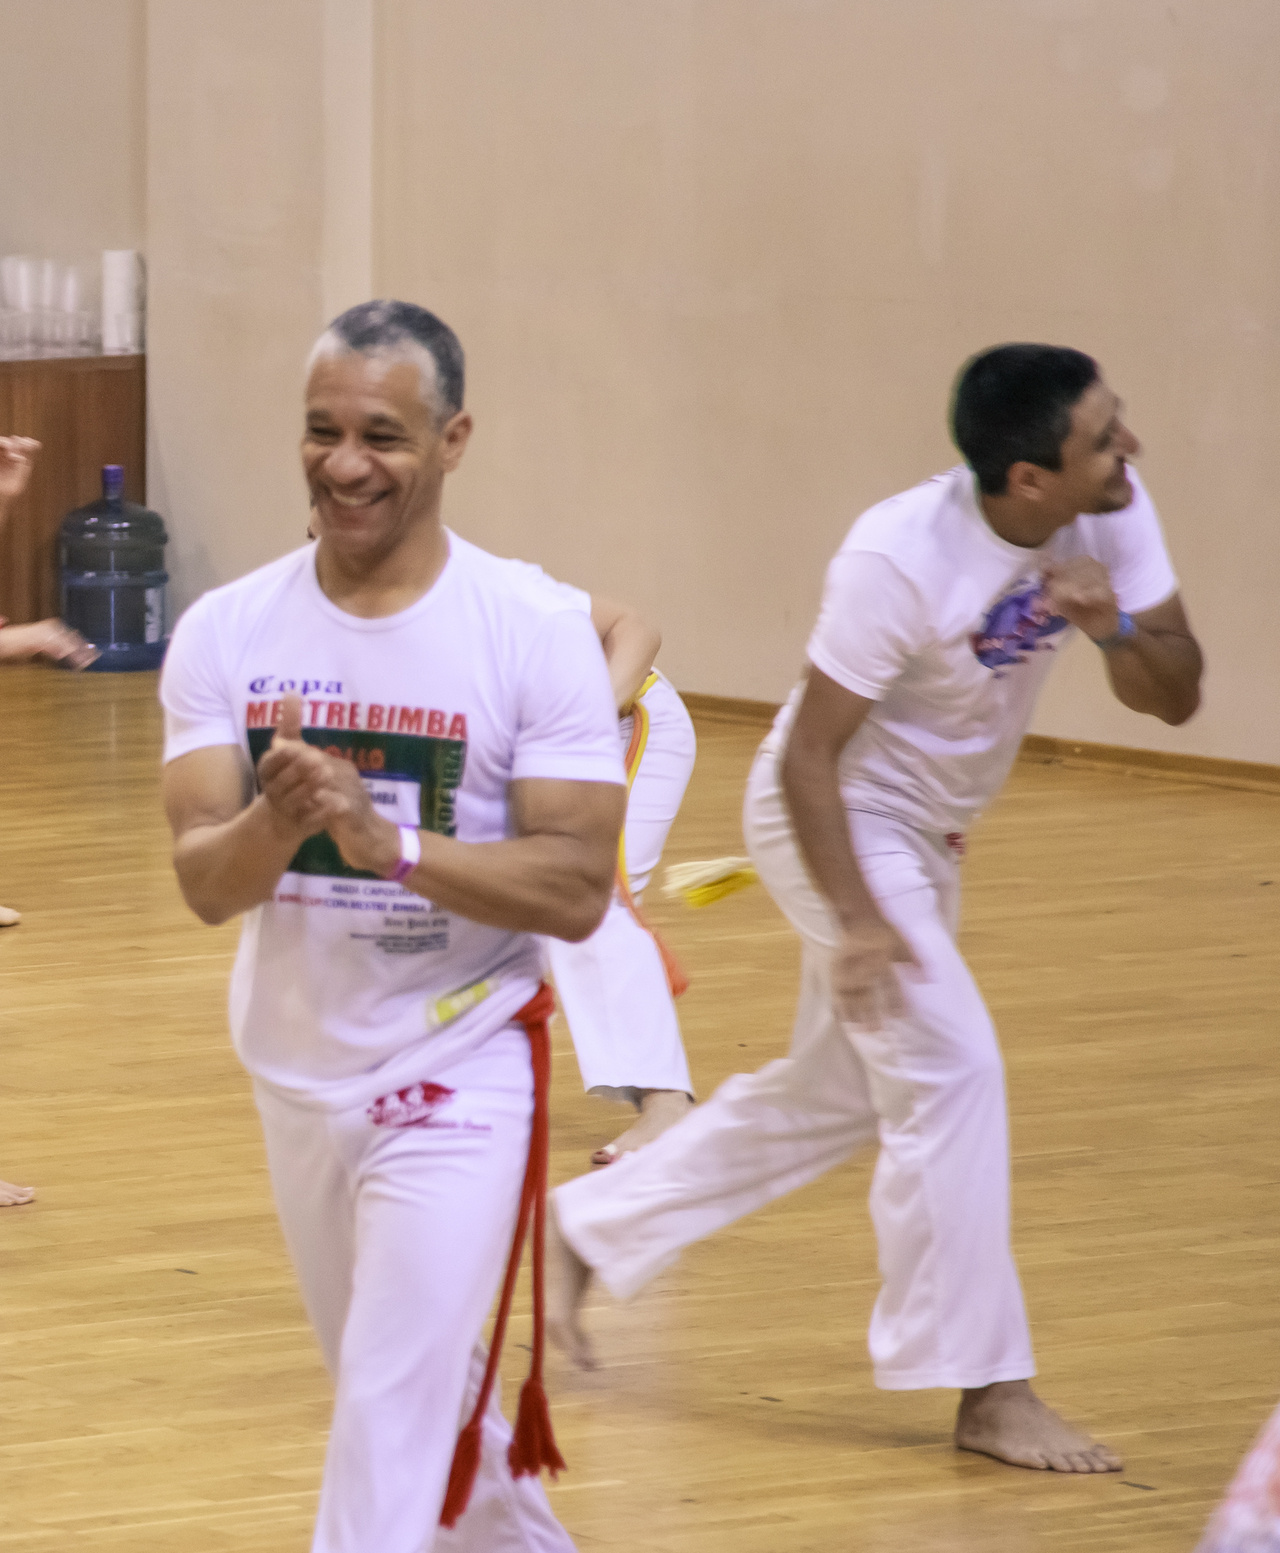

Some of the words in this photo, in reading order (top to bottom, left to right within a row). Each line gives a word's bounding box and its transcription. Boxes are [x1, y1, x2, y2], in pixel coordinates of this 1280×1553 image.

[249, 675, 343, 695] Copa
[246, 701, 361, 731] METRE
[366, 703, 468, 741] BIMBA
